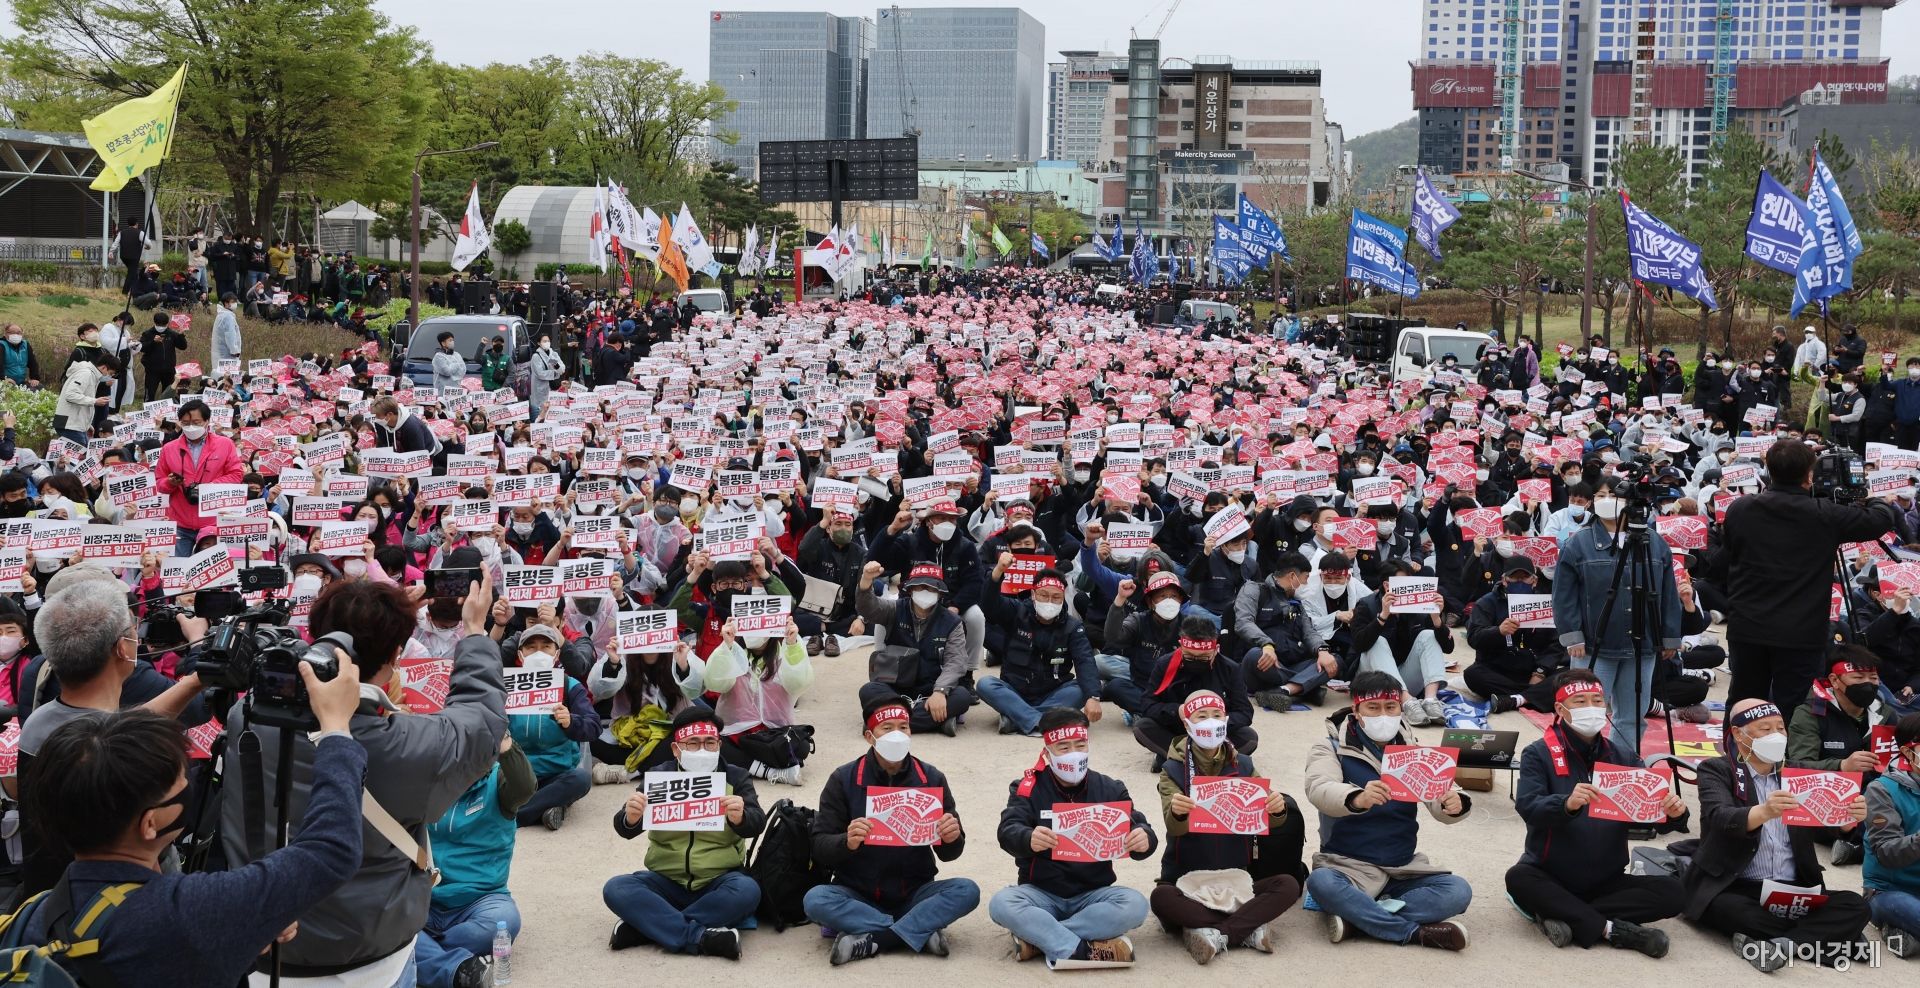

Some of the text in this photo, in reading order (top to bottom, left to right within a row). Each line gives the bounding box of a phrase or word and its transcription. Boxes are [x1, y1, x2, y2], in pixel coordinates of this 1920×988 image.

[1205, 77, 1218, 133] 세운상가
[673, 421, 699, 430] 불평등
[624, 434, 651, 445] 불평등
[720, 440, 744, 449] 불평등
[929, 437, 948, 448] 비정규직
[308, 445, 330, 458] 비정규직
[586, 451, 615, 462] 불평등
[685, 447, 713, 458] 불평등
[834, 453, 856, 462] 비정규직
[1168, 450, 1196, 461] 불평등
[674, 464, 706, 478] 불평등
[760, 468, 791, 480] 불평등
[110, 476, 148, 496] 불평등
[421, 482, 443, 491] 비정규직
[495, 478, 526, 492] 불평등
[720, 473, 752, 486] 불평등
[1172, 477, 1194, 489] 비정규직
[1295, 476, 1315, 485] 비정규직
[577, 481, 609, 493] 불평등
[905, 483, 930, 494] 비정규직
[1355, 484, 1376, 493] 비정규직
[201, 491, 230, 501] 비정규직
[454, 501, 490, 516] 불평등
[575, 518, 611, 533] 불평등
[1208, 516, 1227, 535] 비정규직
[33, 529, 62, 540] 비정규직
[84, 532, 142, 546] 비정규직 없는
[323, 528, 352, 539] 비정규직
[705, 525, 748, 544] 불평등
[1109, 530, 1132, 538] 비정규직
[114, 542, 142, 554] 일자리
[710, 539, 753, 555] 체제 교체
[185, 560, 212, 580] 비정규직
[563, 562, 604, 579] 불평등
[504, 568, 554, 587] 불평등
[564, 577, 610, 591] 체제 교체
[510, 585, 558, 600] 체제 교체
[1392, 583, 1435, 594] 비정규직 없는
[733, 598, 781, 617] 불평등
[1511, 602, 1540, 612] 비정규직
[619, 612, 667, 635] 불평등
[738, 615, 787, 631] 체제 교체
[624, 629, 674, 648] 체제 교체
[406, 663, 439, 683] 차별없는
[533, 689, 559, 703] 교체
[1049, 728, 1065, 742] 단결
[1388, 750, 1449, 771] 차별없는 노동권
[1599, 772, 1662, 791] 차별없는 노동권
[1788, 775, 1855, 796] 차별없는 노동권
[647, 776, 712, 804] 불평등
[1196, 781, 1260, 801] 차별없는 노동권
[872, 791, 935, 814] 차별없는 노동권
[653, 799, 719, 822] 체제 교체
[1058, 807, 1122, 829] 차별없는 노동권
